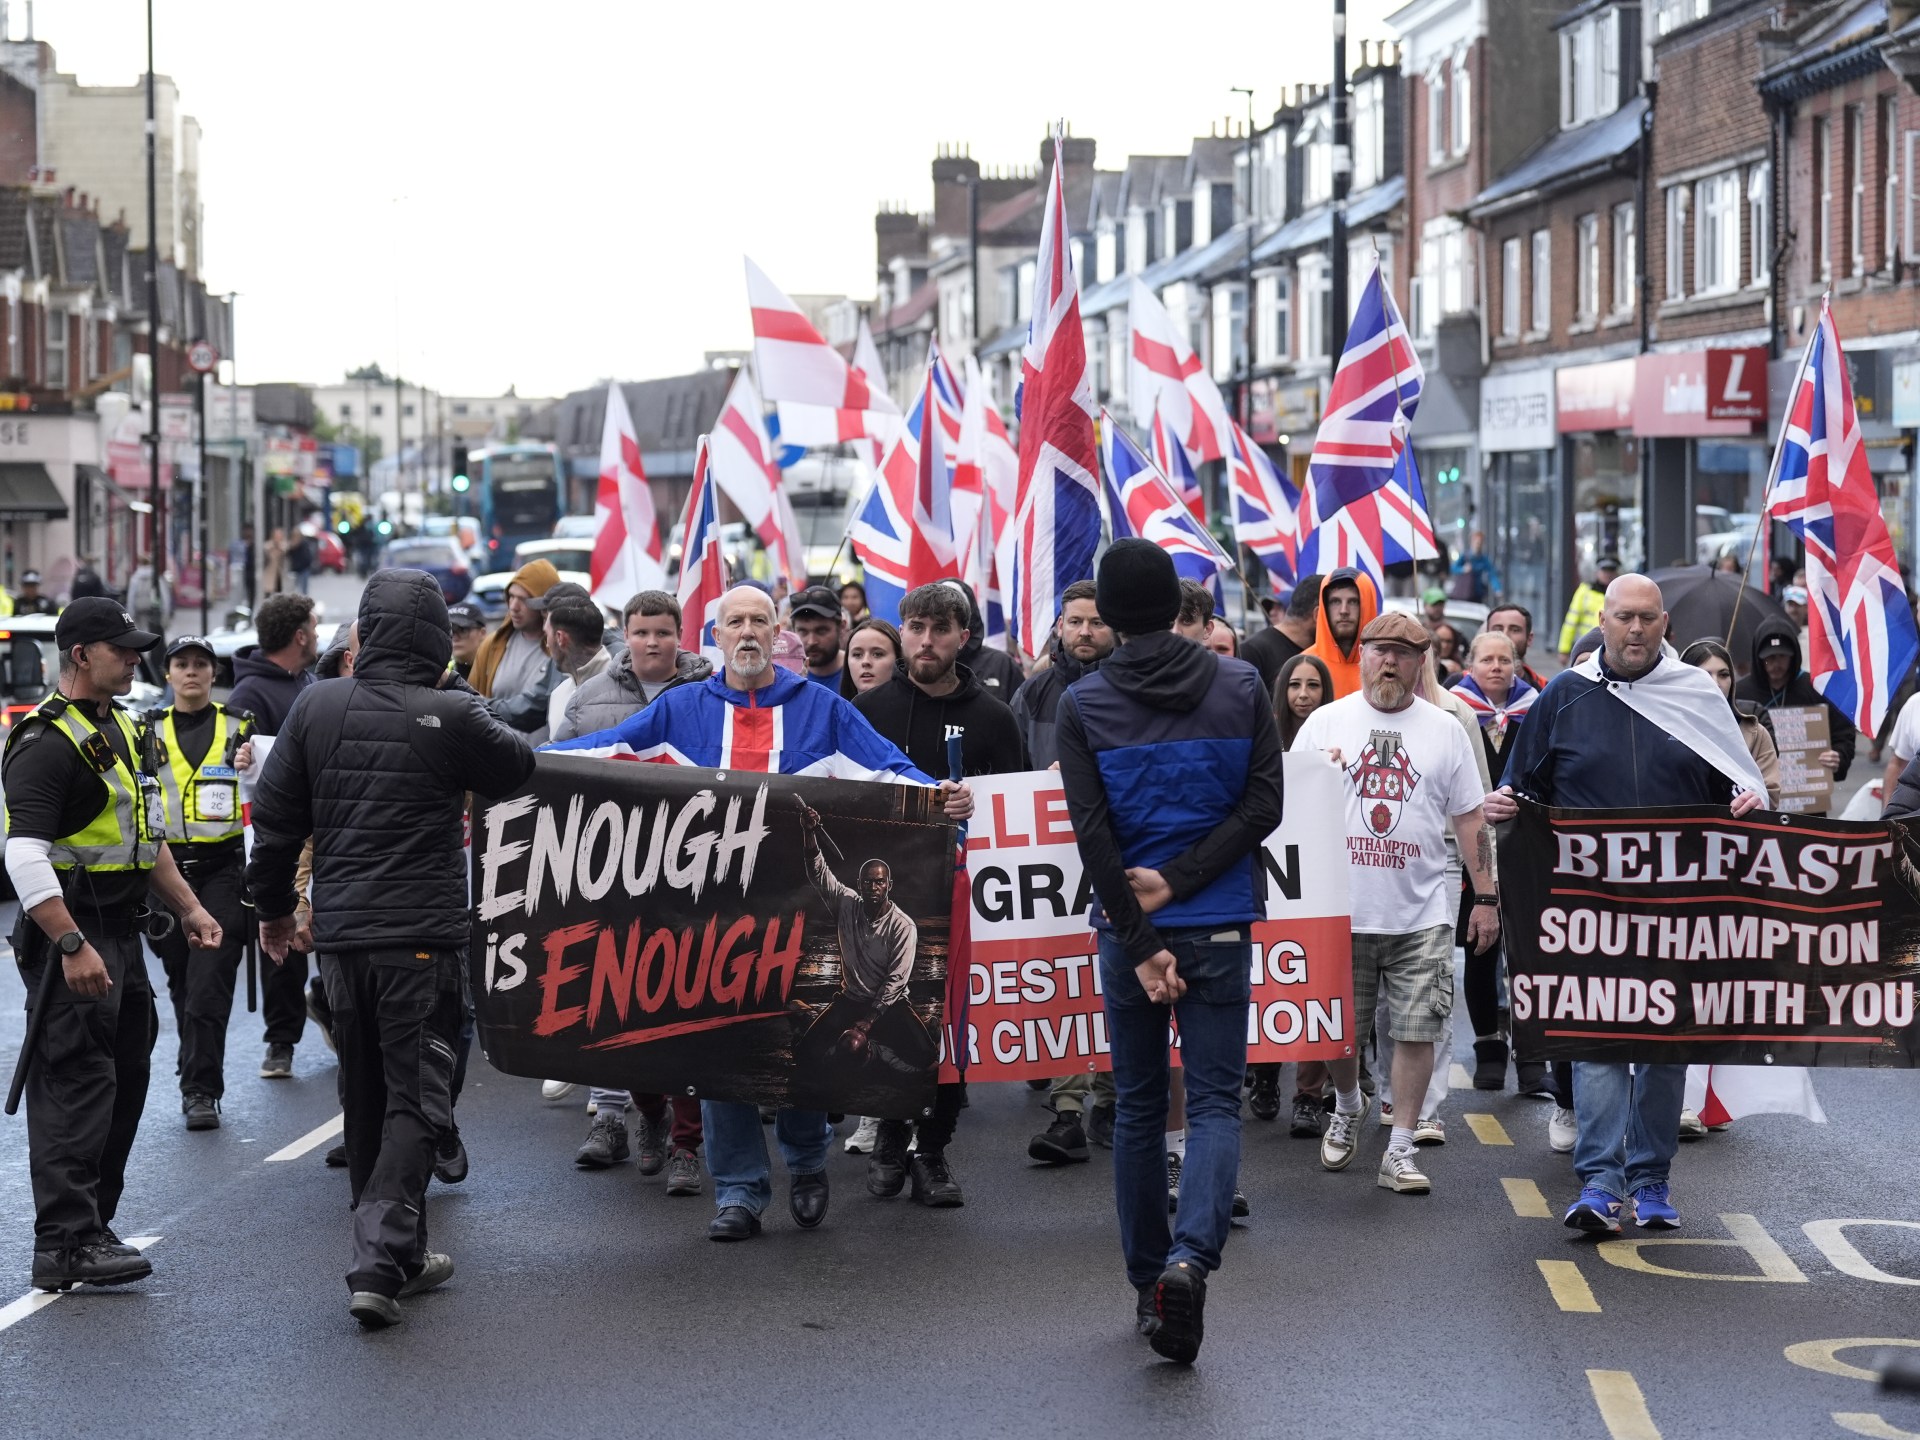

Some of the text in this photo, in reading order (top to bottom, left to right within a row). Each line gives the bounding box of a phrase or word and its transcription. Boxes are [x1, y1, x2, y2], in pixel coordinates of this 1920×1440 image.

[447, 606, 470, 616] OLICE
[178, 636, 207, 647] POLICE
[203, 767, 234, 776] POLICE
[211, 791, 226, 800] HC
[210, 801, 223, 811] 2C
[477, 780, 772, 925] ENOUGH
[1347, 836, 1422, 858] UTHAMPTON
[1351, 851, 1406, 870] PATRIOTS
[1552, 829, 1893, 896] BELFAST
[1538, 906, 1880, 967] SOUTHAMPTON
[532, 910, 805, 1037] ENOUGH
[1512, 973, 1914, 1028] STANDS WITH YOU
